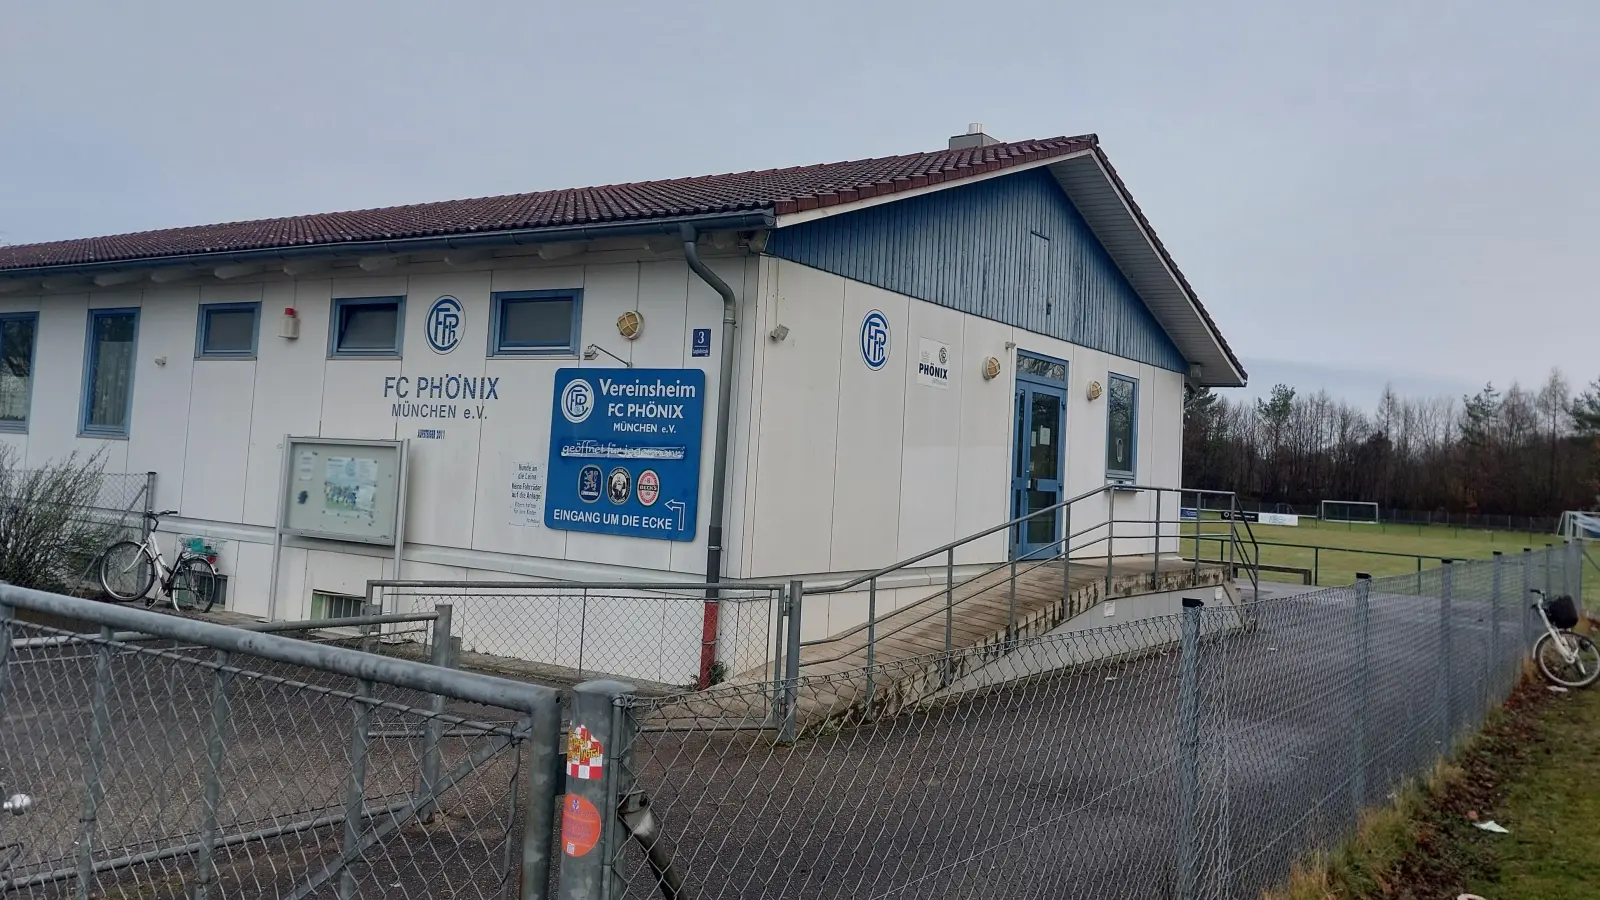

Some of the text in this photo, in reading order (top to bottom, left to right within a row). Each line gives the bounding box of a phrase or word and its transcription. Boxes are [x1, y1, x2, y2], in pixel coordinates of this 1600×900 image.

[697, 331, 705, 344] 3
[918, 362, 948, 380] PHÖNIX
[384, 373, 500, 400] FC PHÖNIX
[599, 378, 696, 398] Vereinsheim
[391, 401, 488, 420] MÜNCHEN e.V.
[607, 401, 684, 419] FC PHÖNIX
[613, 421, 677, 434] MÜNCHEN e.V.
[562, 440, 605, 457] geöffnet
[553, 508, 600, 524] EINGANG
[602, 513, 619, 526] UM
[621, 515, 639, 527] DIE
[642, 516, 673, 530] ECKE
